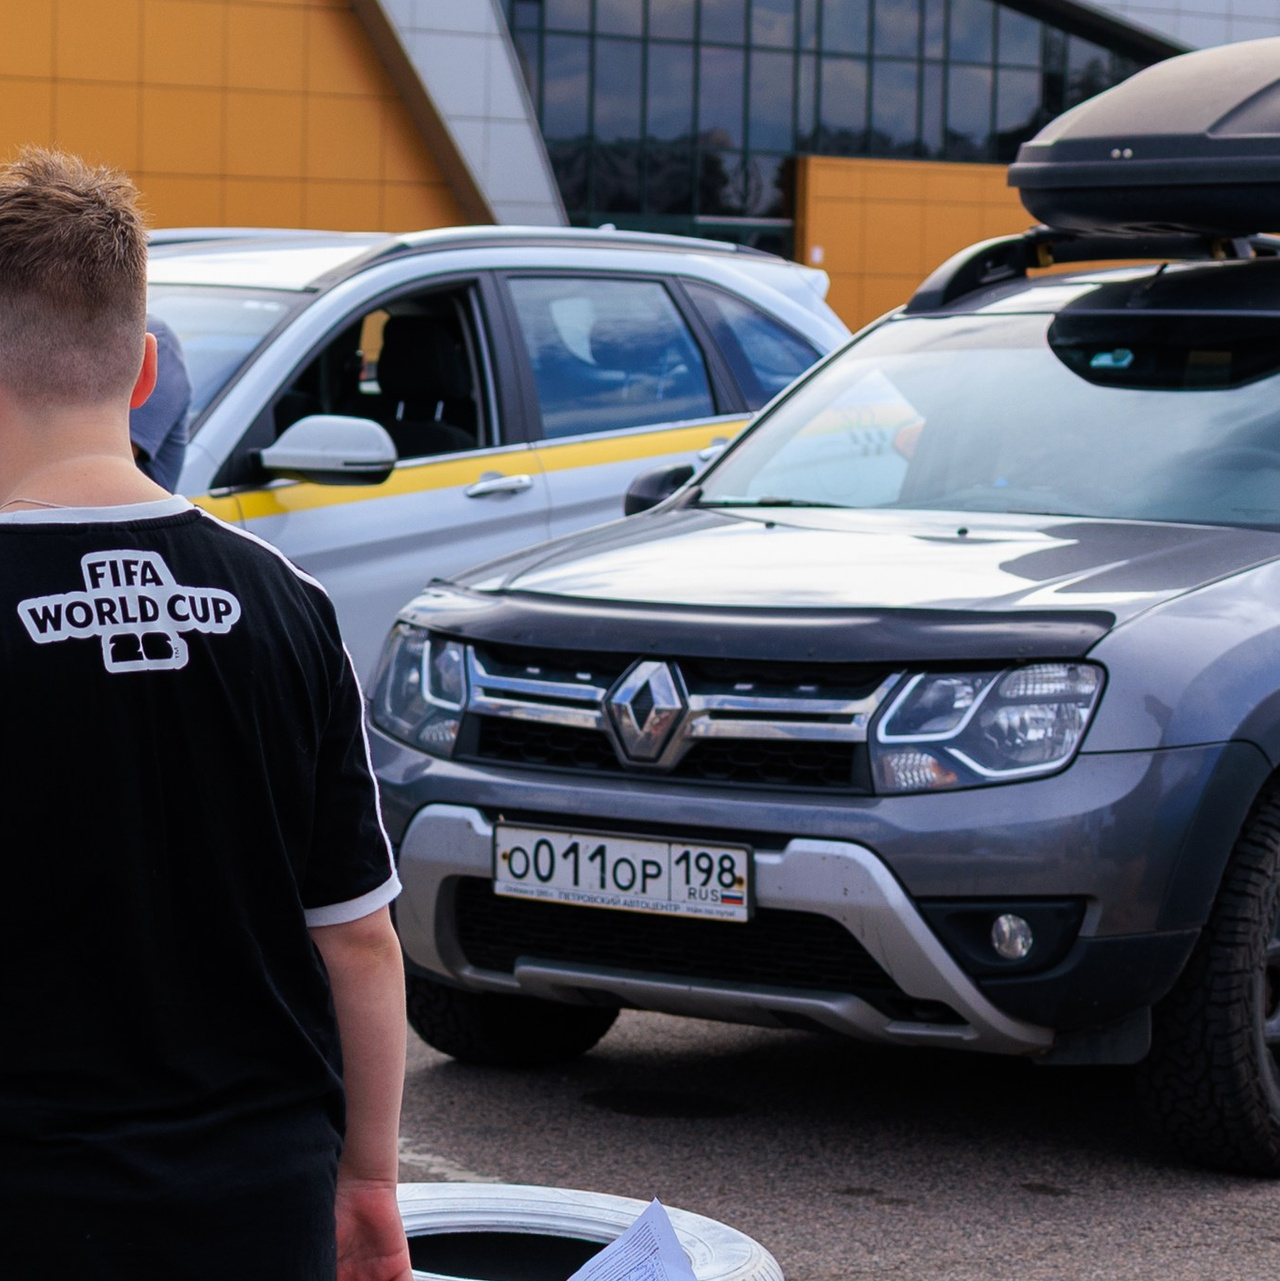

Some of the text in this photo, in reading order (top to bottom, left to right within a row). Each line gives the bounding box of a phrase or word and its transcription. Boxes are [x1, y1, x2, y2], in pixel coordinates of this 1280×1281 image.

[87, 559, 164, 589] FIFA
[27, 593, 232, 634] WORLD CUP
[108, 632, 174, 663] 26
[674, 849, 737, 889] 198
[687, 887, 719, 903] RUS
